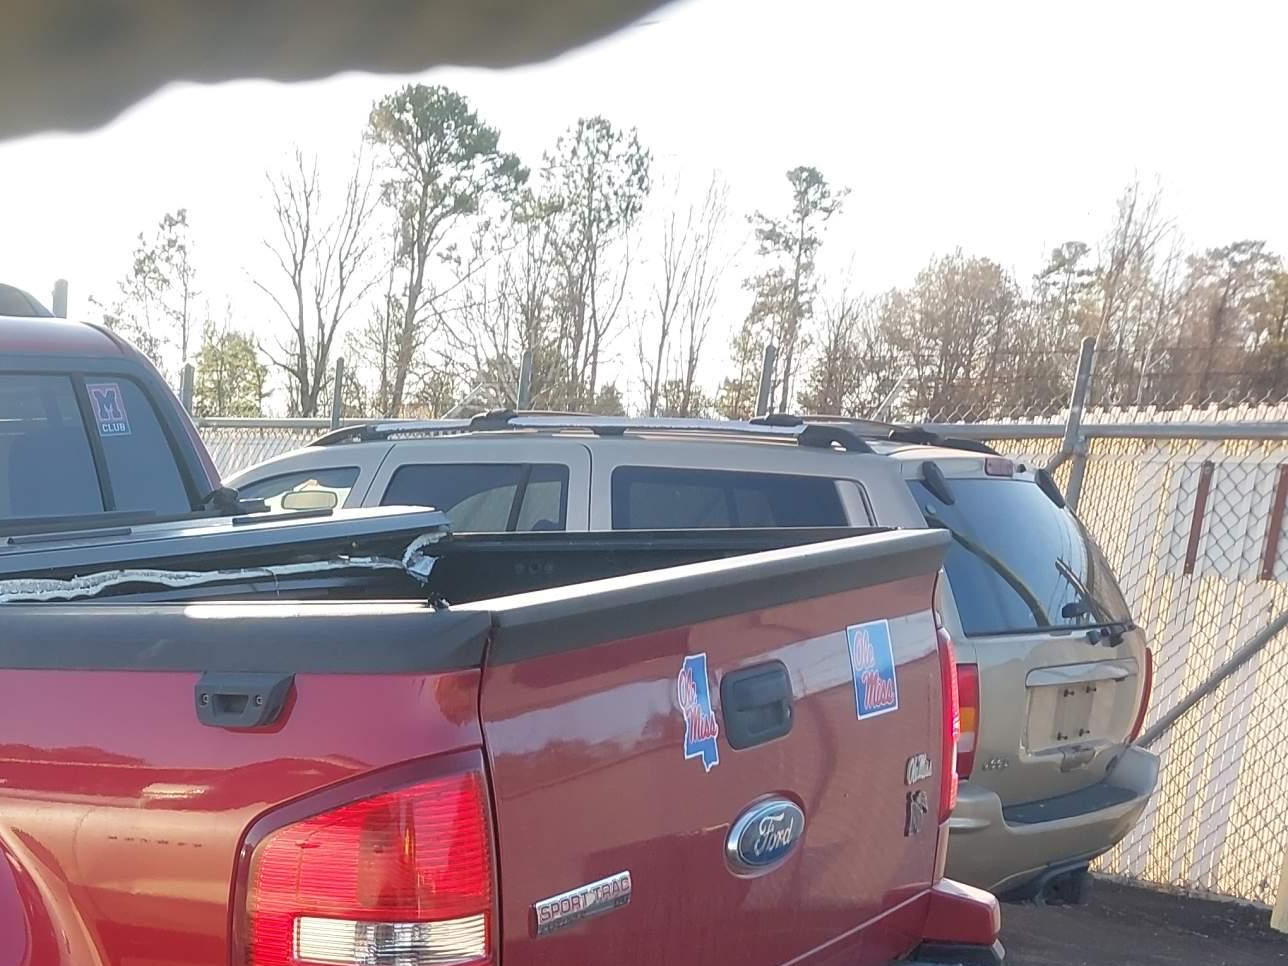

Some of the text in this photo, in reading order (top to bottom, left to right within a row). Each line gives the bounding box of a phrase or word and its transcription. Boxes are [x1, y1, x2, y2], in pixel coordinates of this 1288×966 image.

[91, 389, 123, 421] M
[102, 423, 126, 433] CLUB
[854, 630, 875, 671] Ole
[678, 668, 697, 710] Ole
[862, 669, 894, 710] Miss
[687, 704, 718, 743] Miss
[754, 812, 794, 857] Ford
[540, 891, 589, 921] SPORT
[592, 877, 630, 901] TRAC
